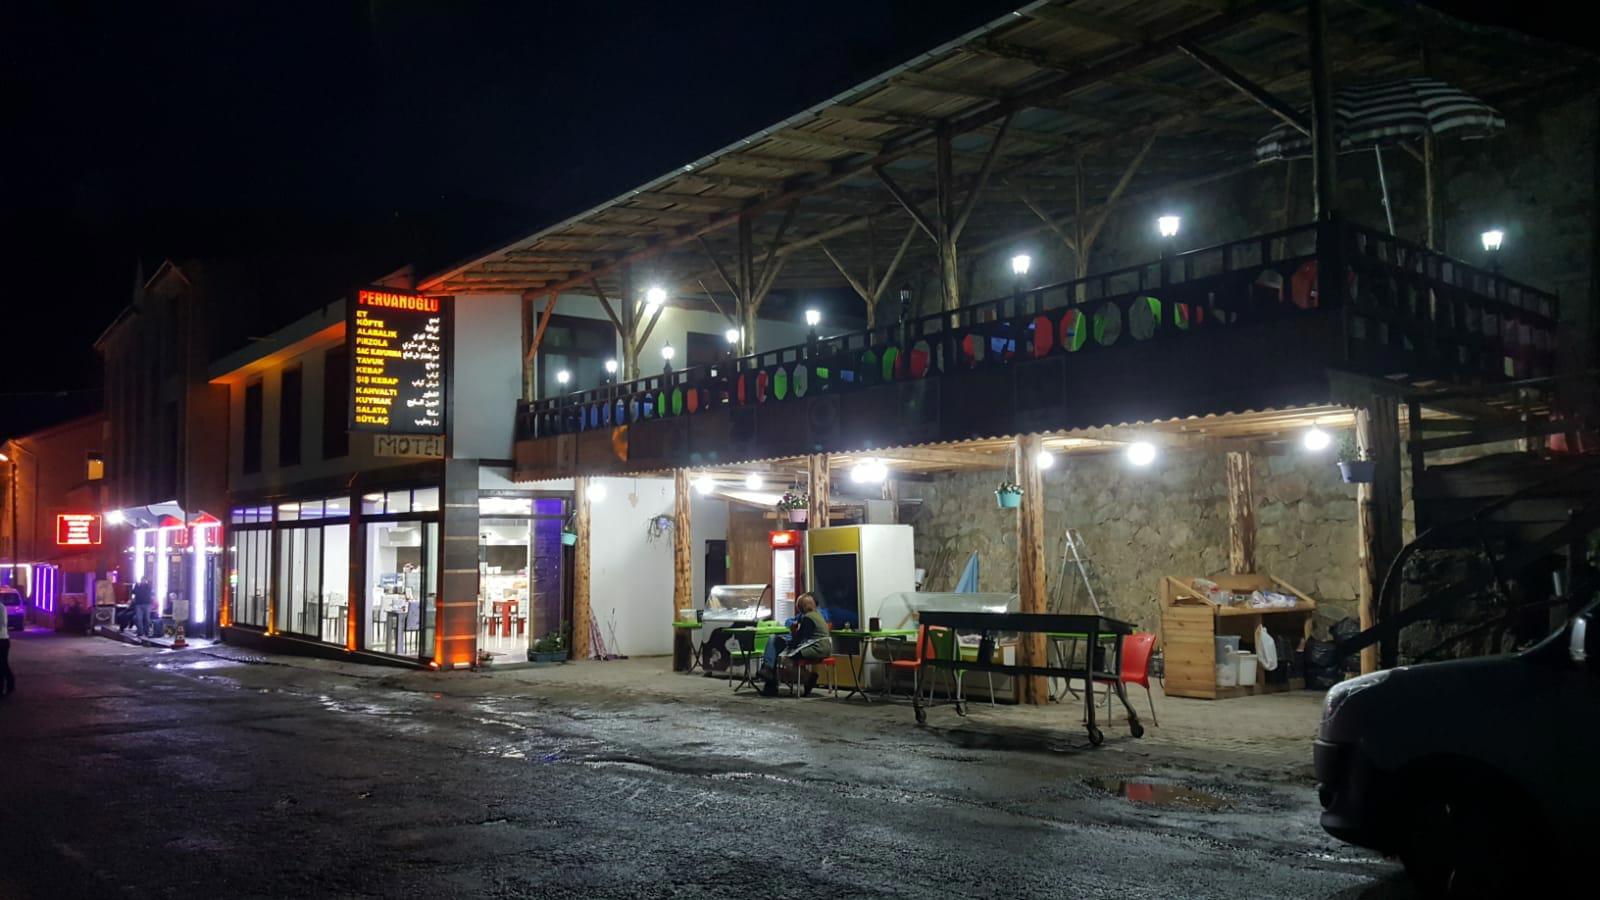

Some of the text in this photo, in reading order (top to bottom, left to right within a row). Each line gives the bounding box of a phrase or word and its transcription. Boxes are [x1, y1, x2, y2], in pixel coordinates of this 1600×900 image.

[359, 290, 439, 312] PERVANOĞLU
[356, 310, 368, 318] ET
[356, 318, 384, 328] KÖFTE
[357, 328, 398, 338] ALABALIK
[356, 357, 384, 366] TAVUK
[356, 366, 384, 375] KEBAP
[371, 377, 398, 385] KEBAP
[356, 387, 397, 396] KAHVALTI
[356, 397, 392, 405] KUYMAK
[356, 406, 388, 415] SALATA
[378, 437, 442, 457] MOTEL
